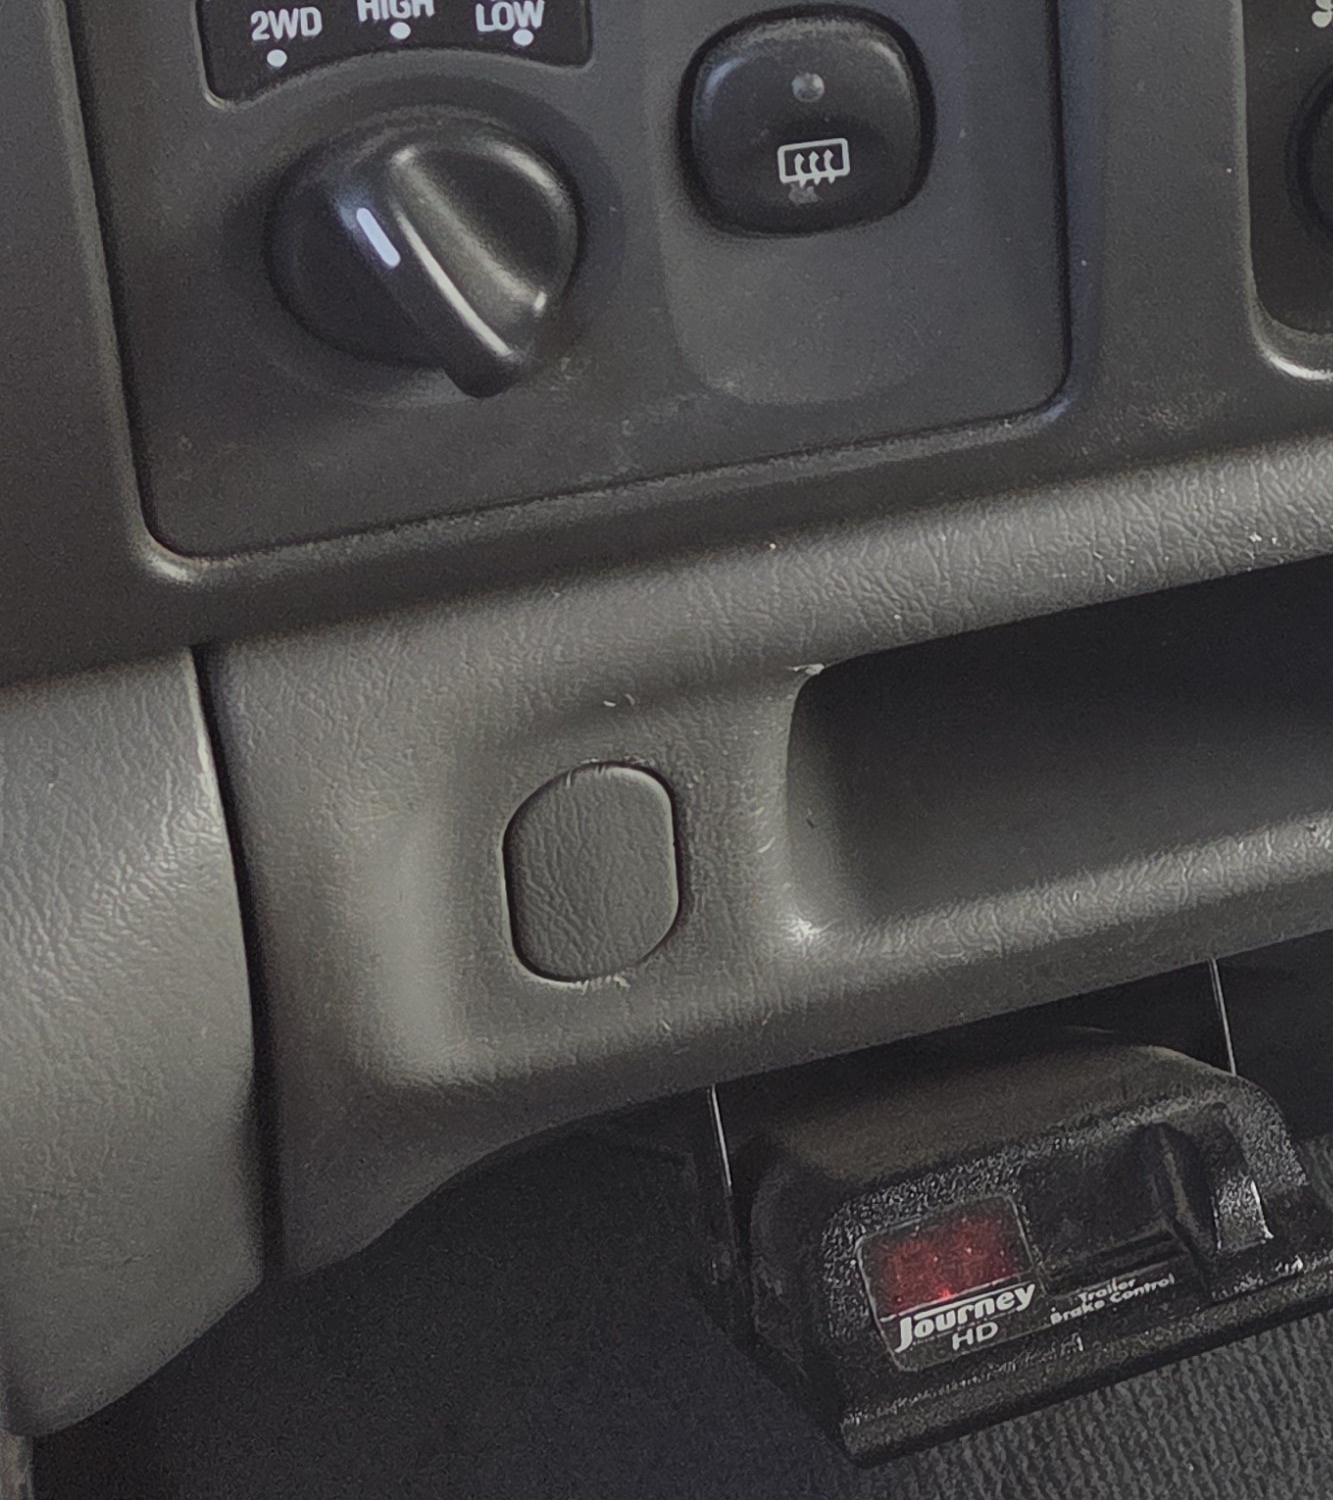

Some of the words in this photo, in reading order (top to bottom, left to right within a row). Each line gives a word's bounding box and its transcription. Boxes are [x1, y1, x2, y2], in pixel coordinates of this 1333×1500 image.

[250, 6, 322, 41] 2WD
[1050, 1298, 1106, 1326] Brake
[1109, 1273, 1176, 1304] Control
[1077, 1276, 1137, 1304] Trailer
[895, 1284, 1036, 1353] Journey
[951, 1321, 999, 1350] HD
